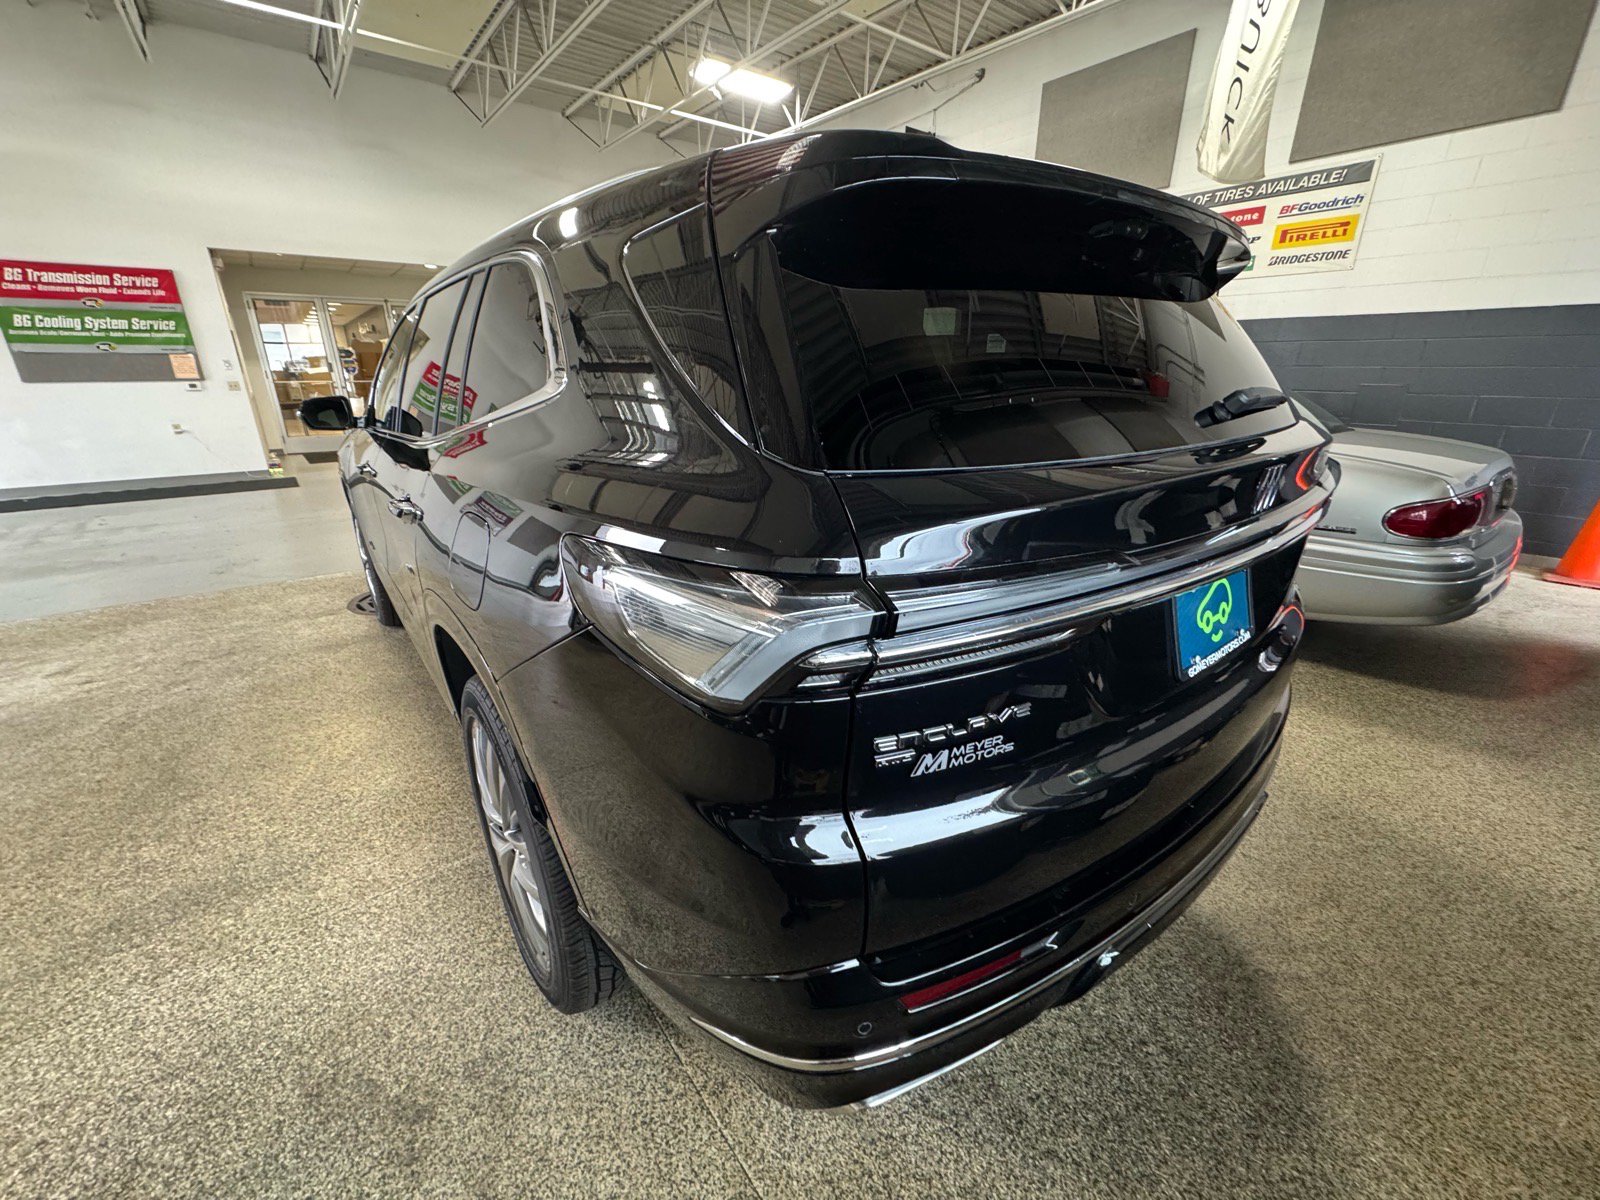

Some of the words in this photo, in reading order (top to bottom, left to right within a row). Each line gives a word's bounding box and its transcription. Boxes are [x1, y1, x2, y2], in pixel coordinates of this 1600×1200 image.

[1214, 186, 1255, 203] TIRES
[1256, 168, 1348, 196] AVAILABLE!
[1279, 193, 1364, 215] BFGoodrich
[1279, 221, 1351, 244] PIRELLI
[1267, 249, 1352, 266] BRIDGESTONE
[3, 266, 23, 282] BG
[25, 268, 111, 286] Transmission
[113, 273, 159, 287] Service
[13, 314, 32, 328] BG
[35, 314, 82, 331] Cooling
[84, 315, 129, 331] System
[131, 317, 176, 331] Service
[949, 742, 1015, 769] MOTORS
[950, 734, 1004, 758] MEYER
